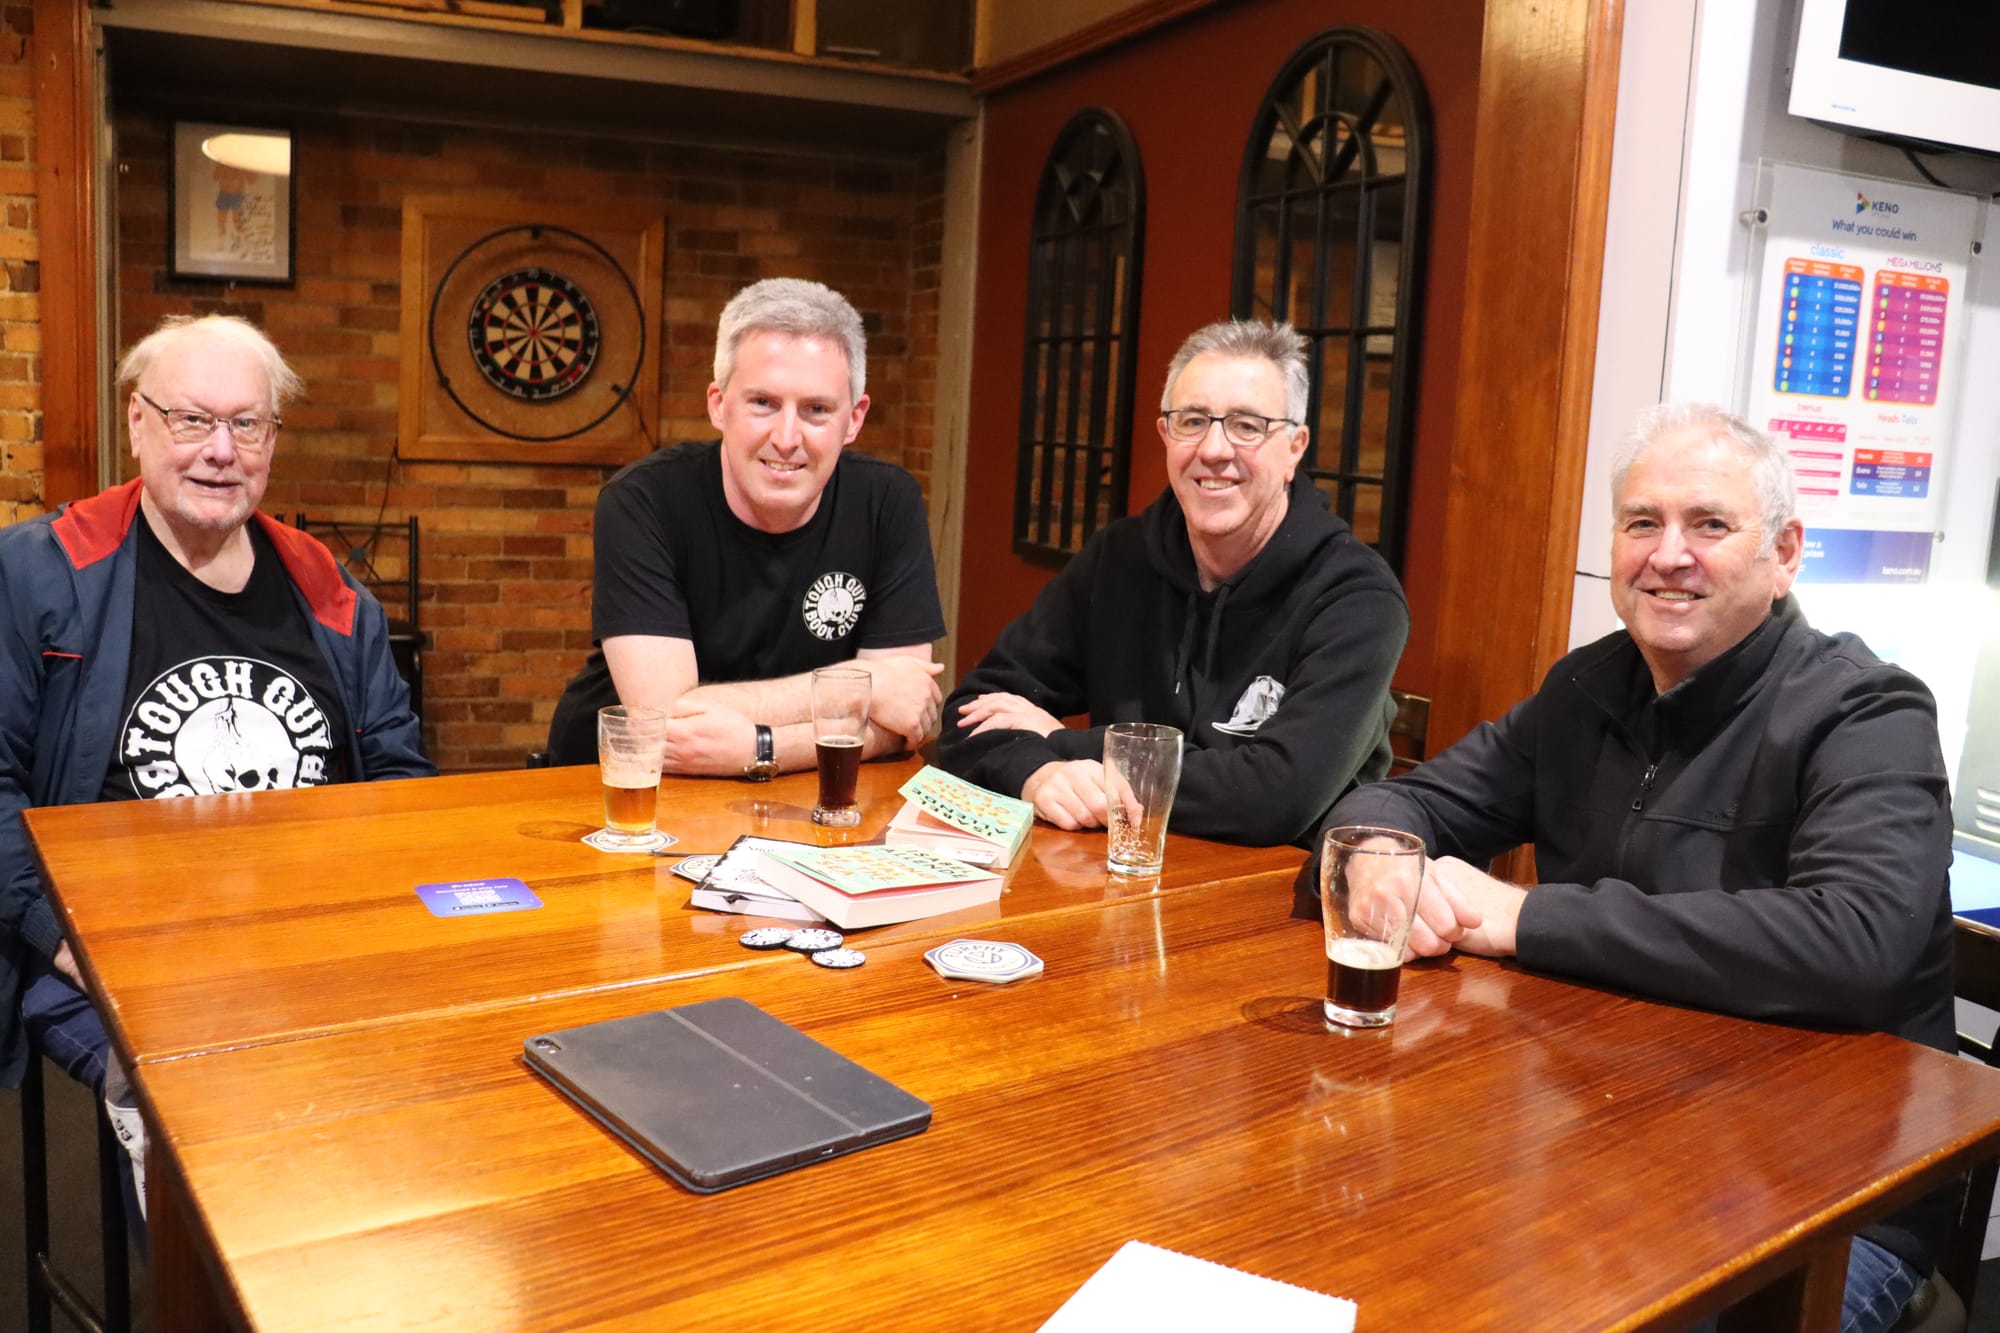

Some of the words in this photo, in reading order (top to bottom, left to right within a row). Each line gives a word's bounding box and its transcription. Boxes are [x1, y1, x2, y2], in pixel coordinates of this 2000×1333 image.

[1872, 201, 1900, 214] KENO
[1832, 218, 1855, 232] What
[1856, 224, 1873, 236] you
[1875, 228, 1900, 240] could
[1902, 231, 1917, 241] win
[1810, 243, 1845, 259] classic
[1887, 256, 1908, 267] MEGA
[805, 574, 844, 610] TOUGH
[846, 578, 867, 602] GUY
[805, 610, 835, 640] BOOK
[838, 603, 864, 637] CLUB
[126, 661, 254, 757] TOUGH
[263, 676, 331, 752] GUY
[911, 787, 1008, 834] ALLENDE
[880, 847, 969, 878] ALLENDE
